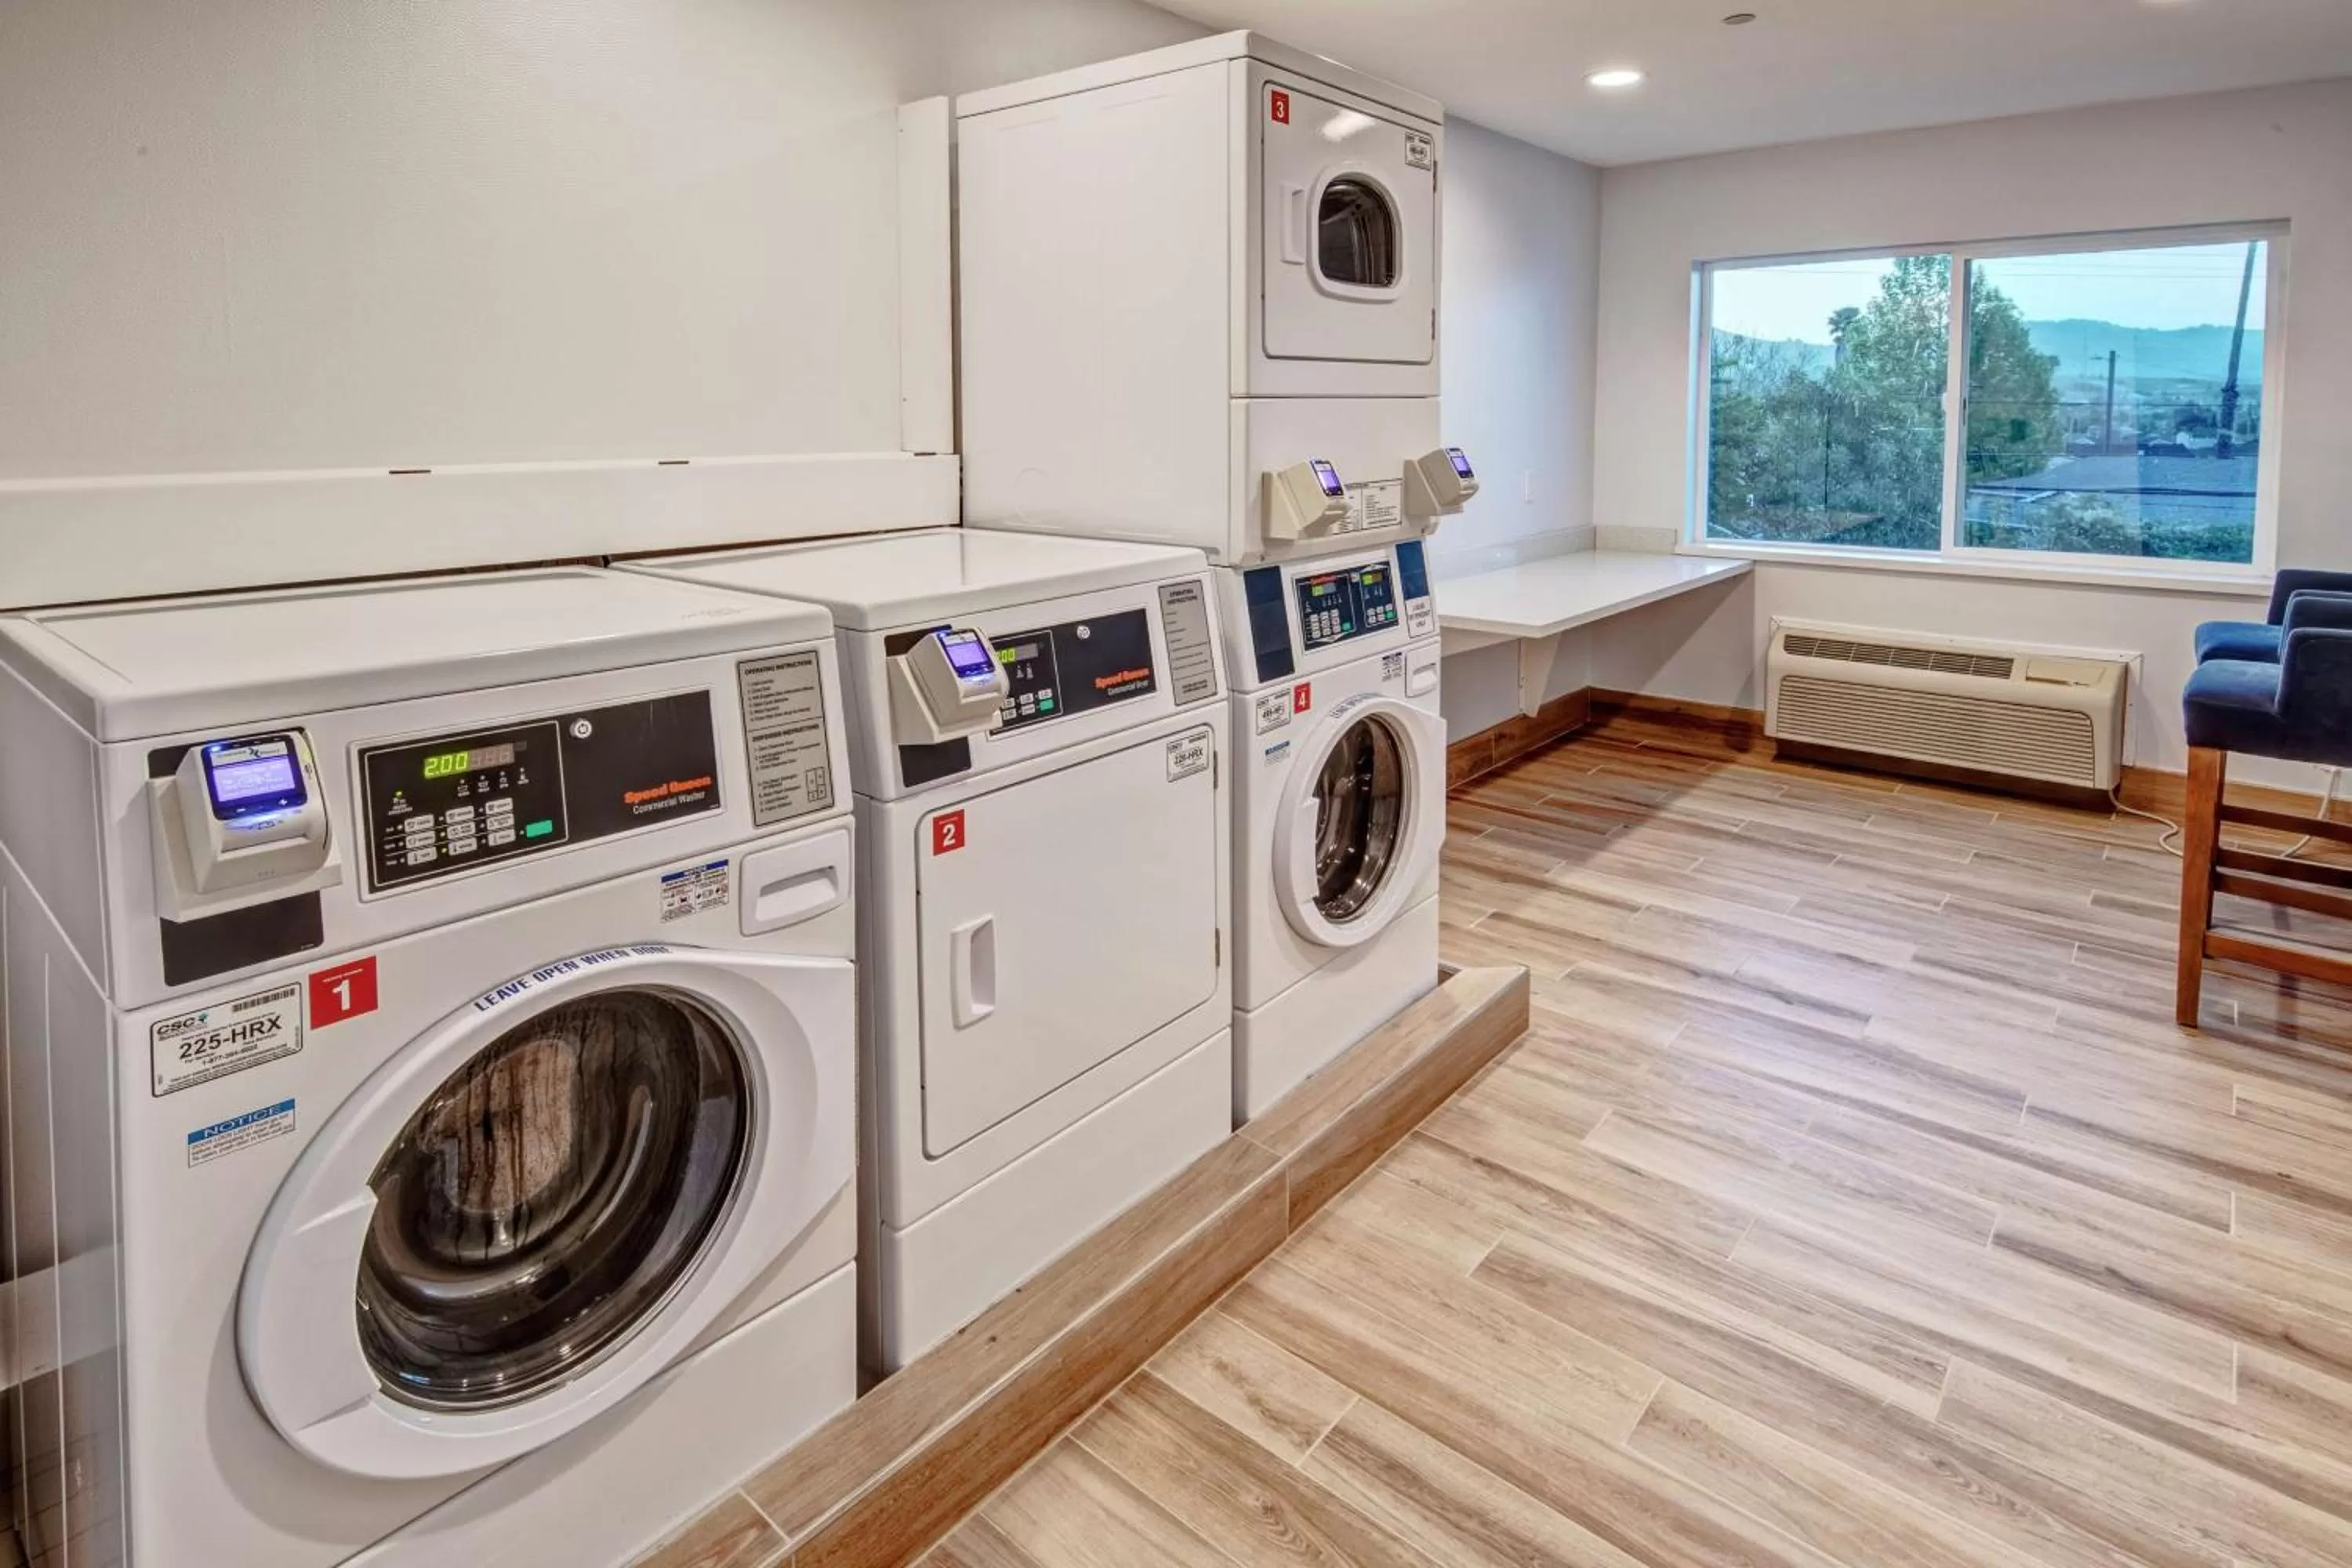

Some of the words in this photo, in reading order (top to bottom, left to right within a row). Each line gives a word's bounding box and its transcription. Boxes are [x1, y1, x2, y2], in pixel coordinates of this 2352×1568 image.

[1276, 100, 1284, 118] 3
[1298, 691, 1306, 709] 4
[424, 751, 468, 775] 2.00
[624, 783, 669, 804] Speed
[943, 824, 956, 847] 2
[474, 978, 534, 1011] LEAVE
[532, 960, 580, 982] OPEN
[580, 949, 630, 964] WHEN
[332, 979, 350, 1011] 1
[157, 1017, 196, 1036] CSC
[179, 1014, 284, 1060] 225-HRX
[204, 1105, 281, 1137] NOTICE
